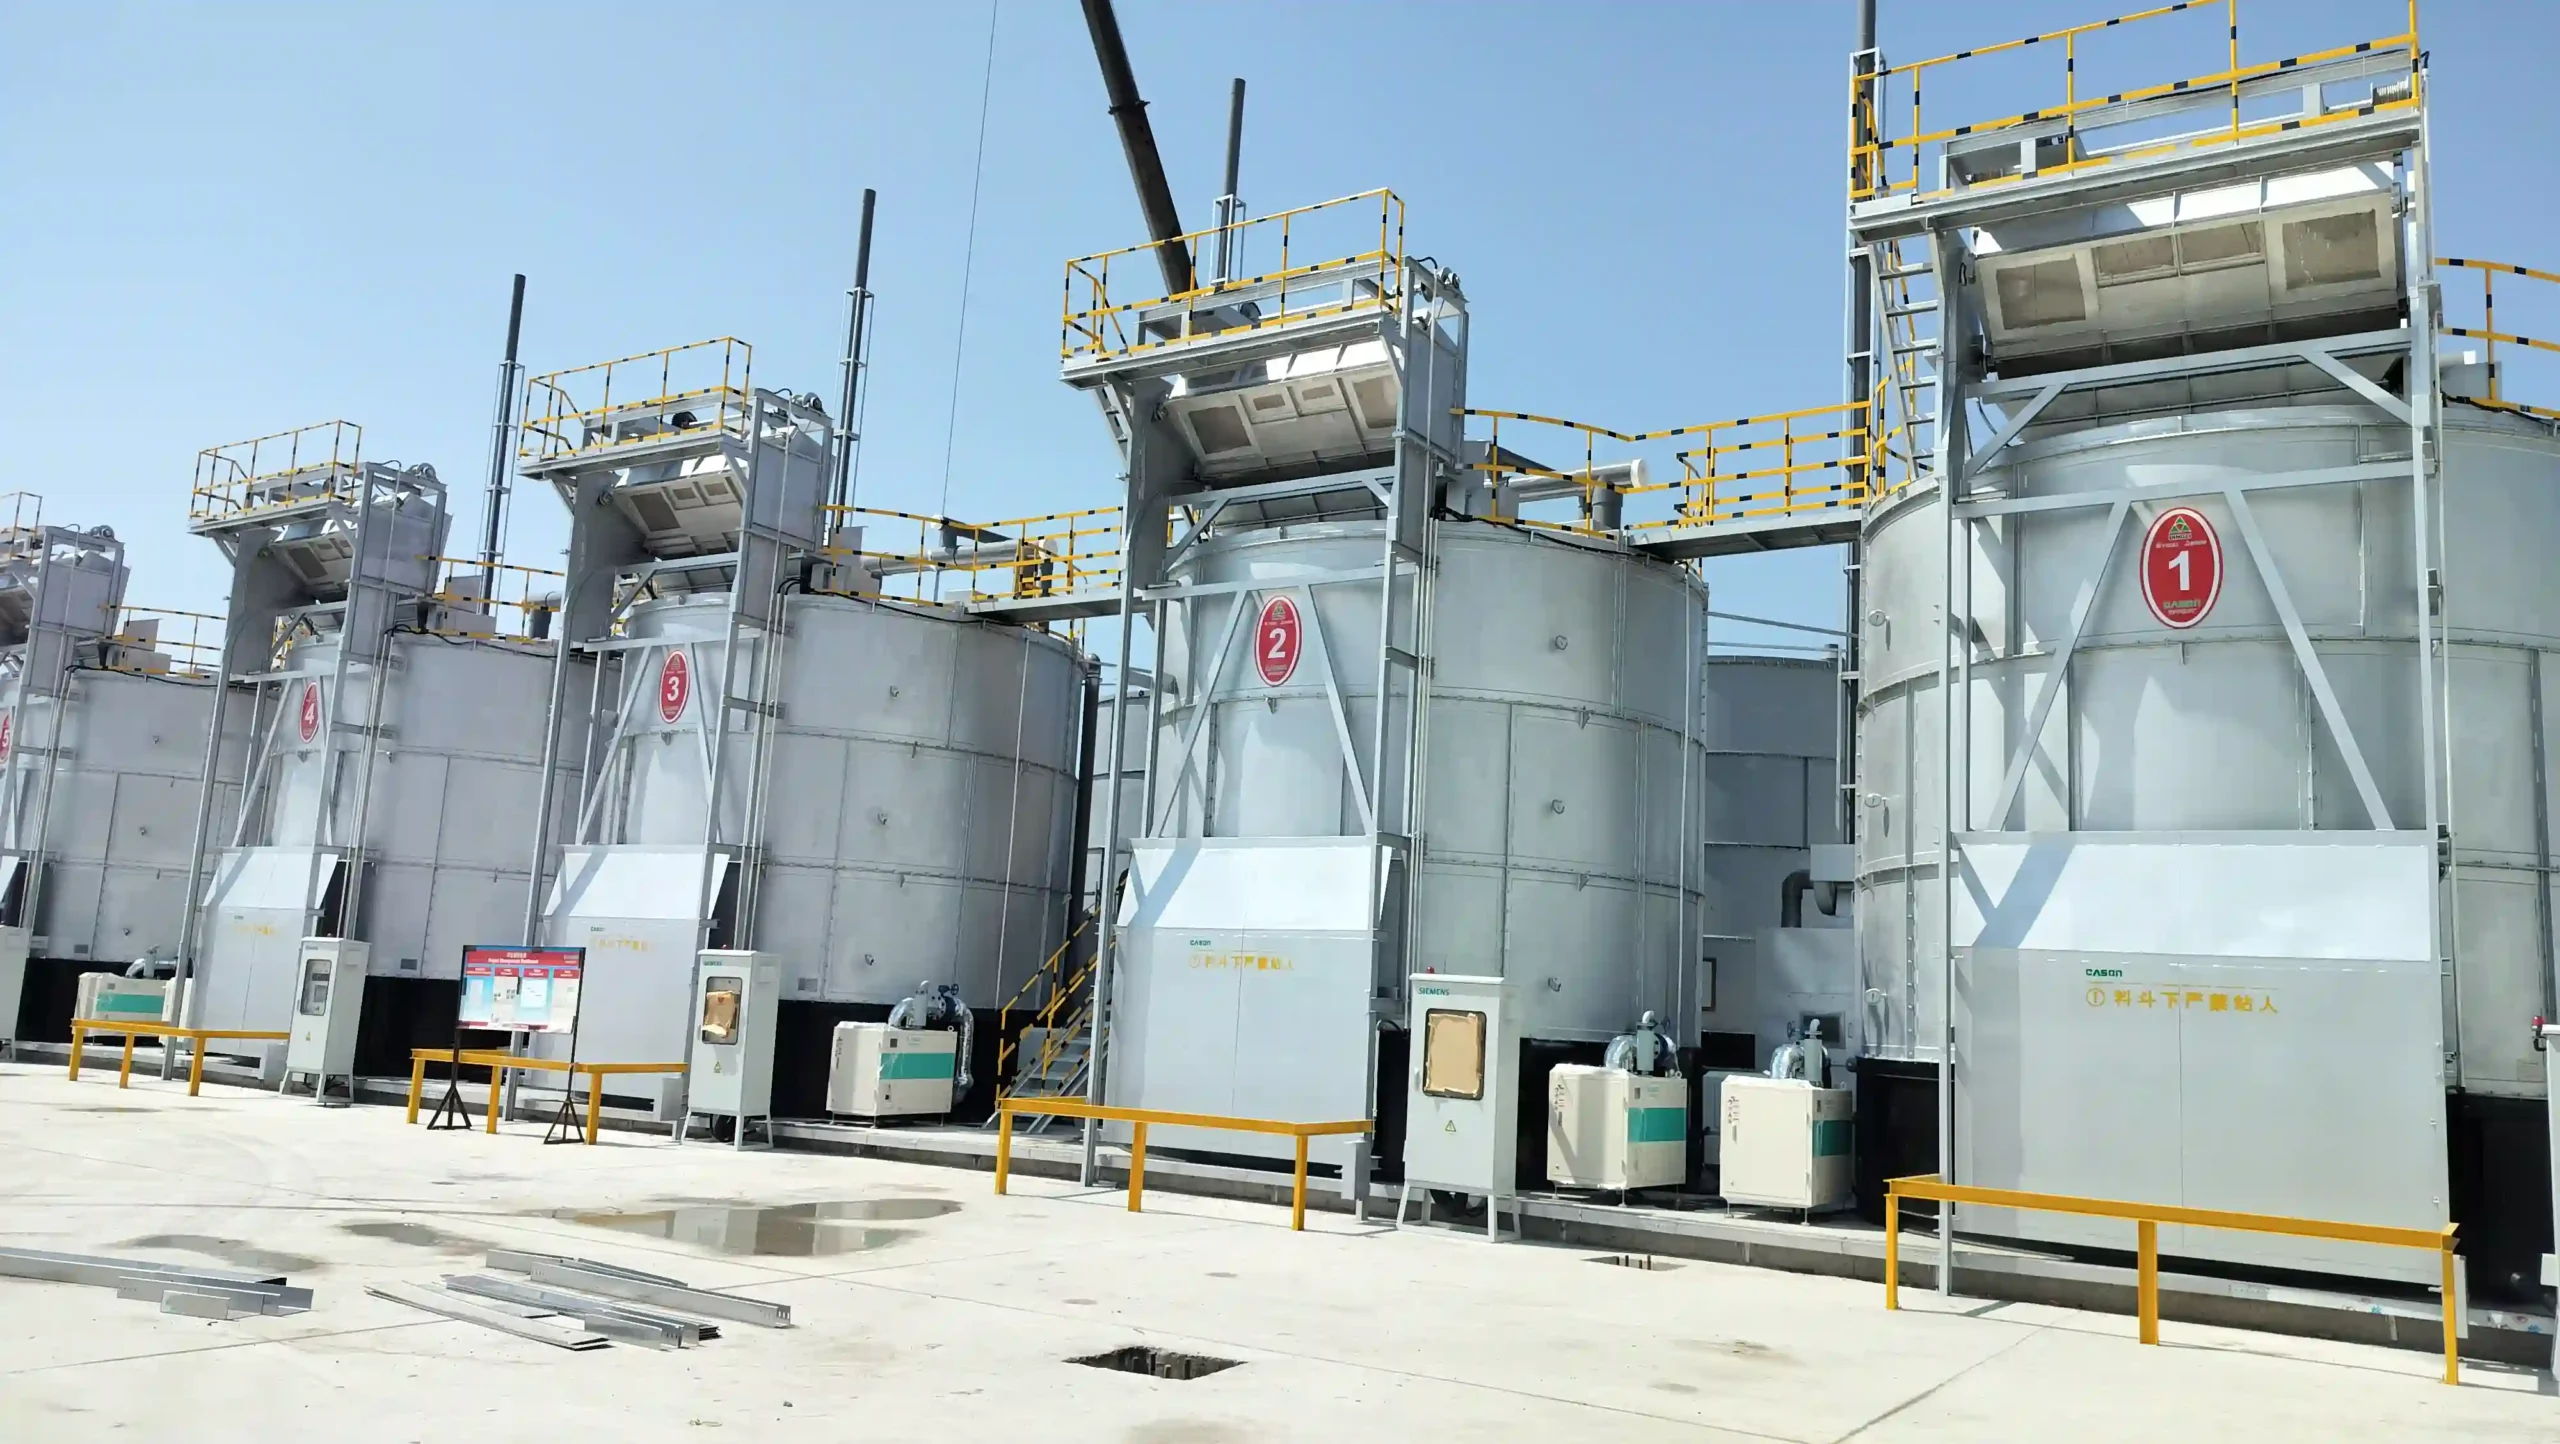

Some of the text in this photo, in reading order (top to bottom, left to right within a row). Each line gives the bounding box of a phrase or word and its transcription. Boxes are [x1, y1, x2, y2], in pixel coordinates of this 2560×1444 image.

[2168, 550, 2190, 591] 1
[1267, 627, 1287, 659] 2
[667, 676, 680, 702] 3
[304, 702, 316, 725] 4
[2, 728, 9, 748] 5
[1419, 987, 1450, 996] SIEMENS
